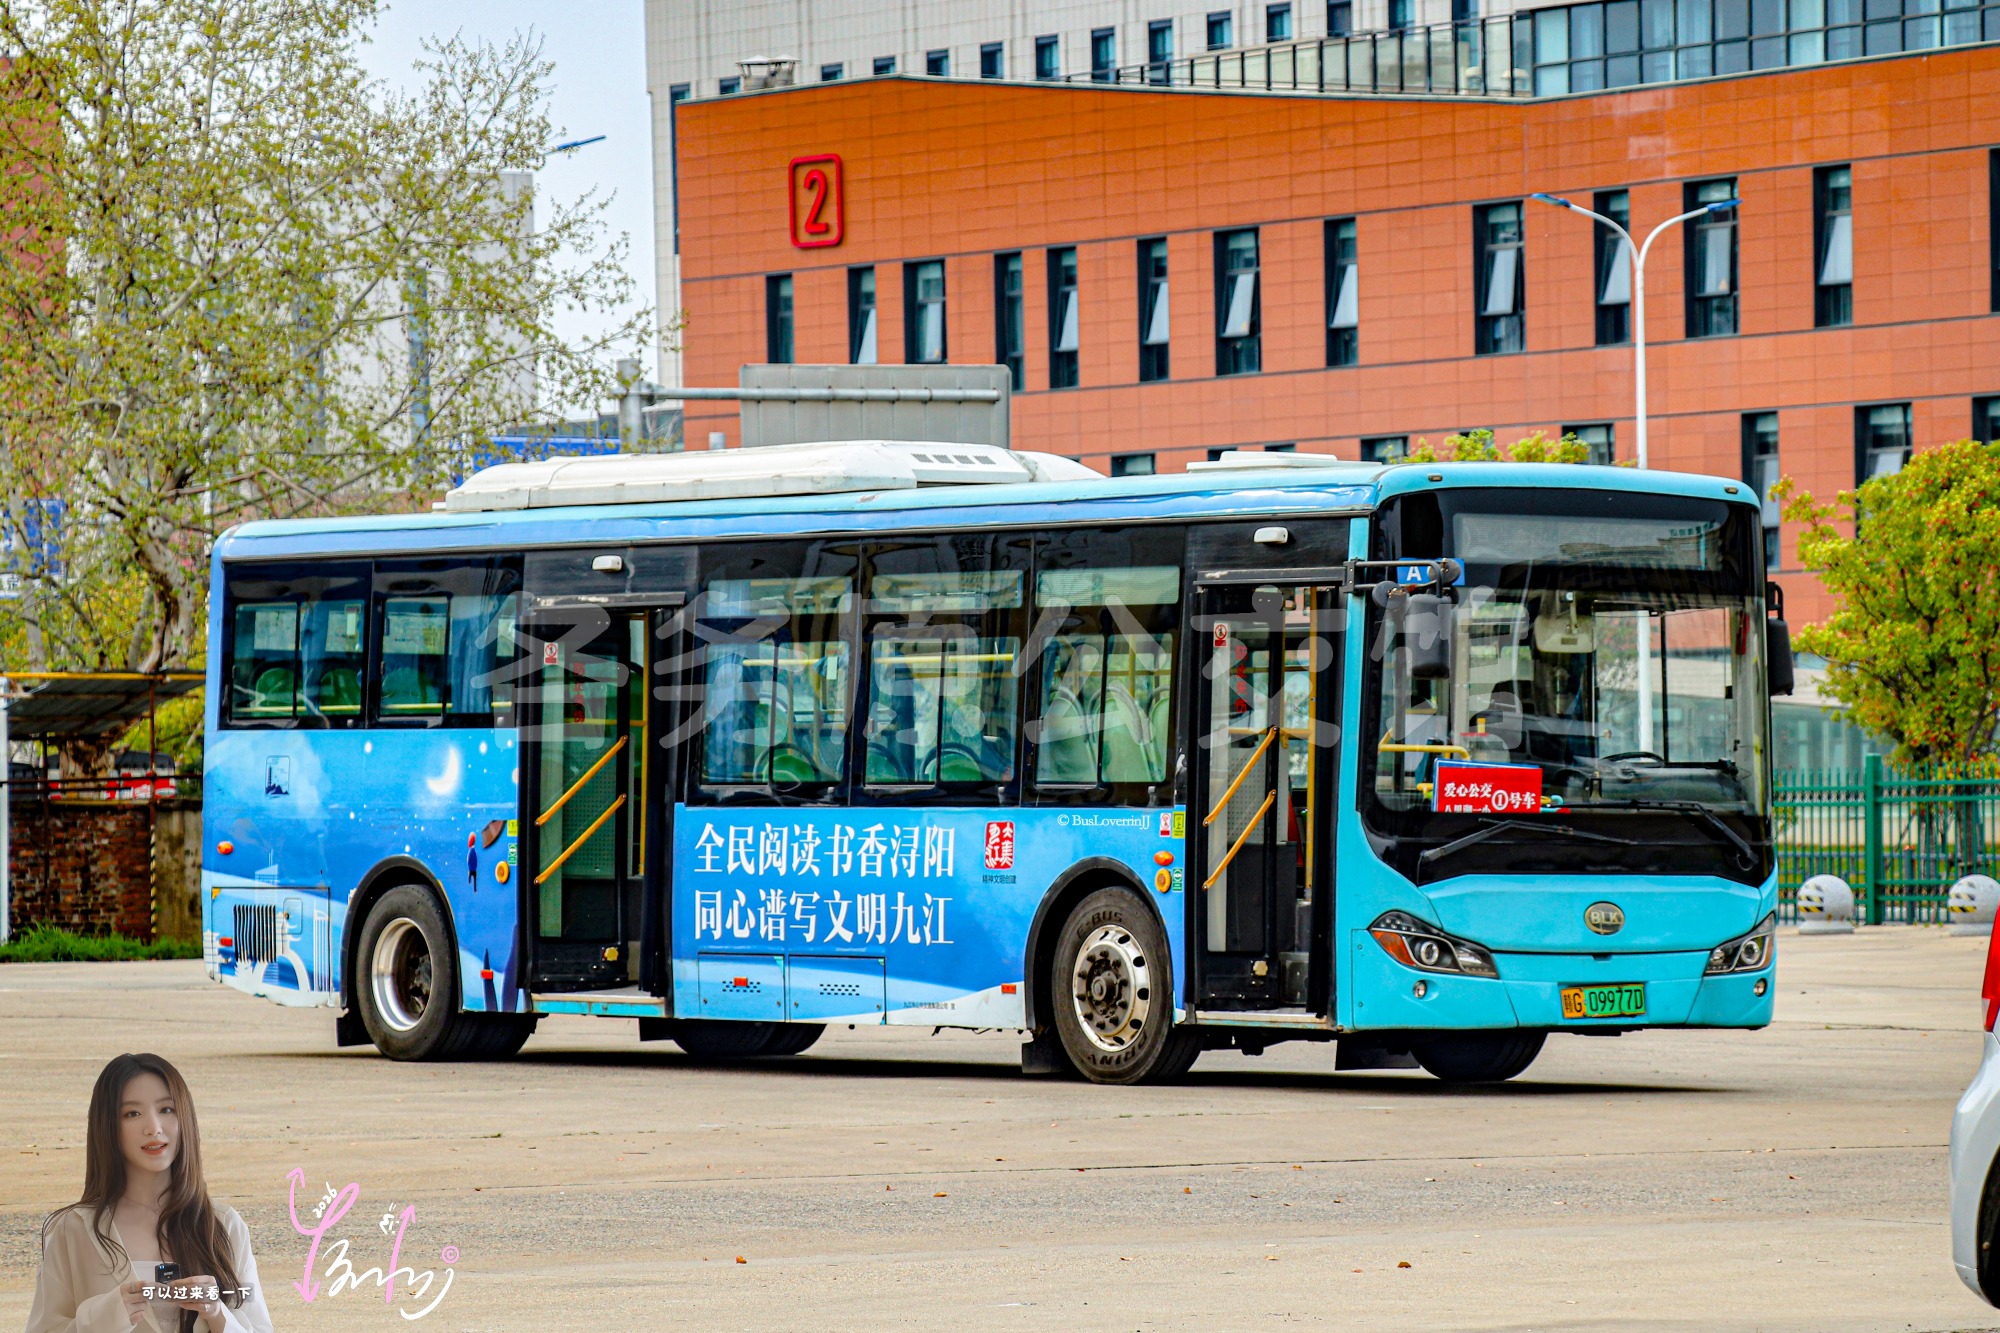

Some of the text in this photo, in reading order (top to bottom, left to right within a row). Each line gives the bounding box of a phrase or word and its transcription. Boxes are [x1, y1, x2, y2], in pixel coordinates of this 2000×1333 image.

[804, 169, 829, 234] 2
[694, 822, 955, 878] 全民阅读书香浔阳
[694, 888, 955, 947] 同心谱写文明九江
[1590, 911, 1621, 924] BLK
